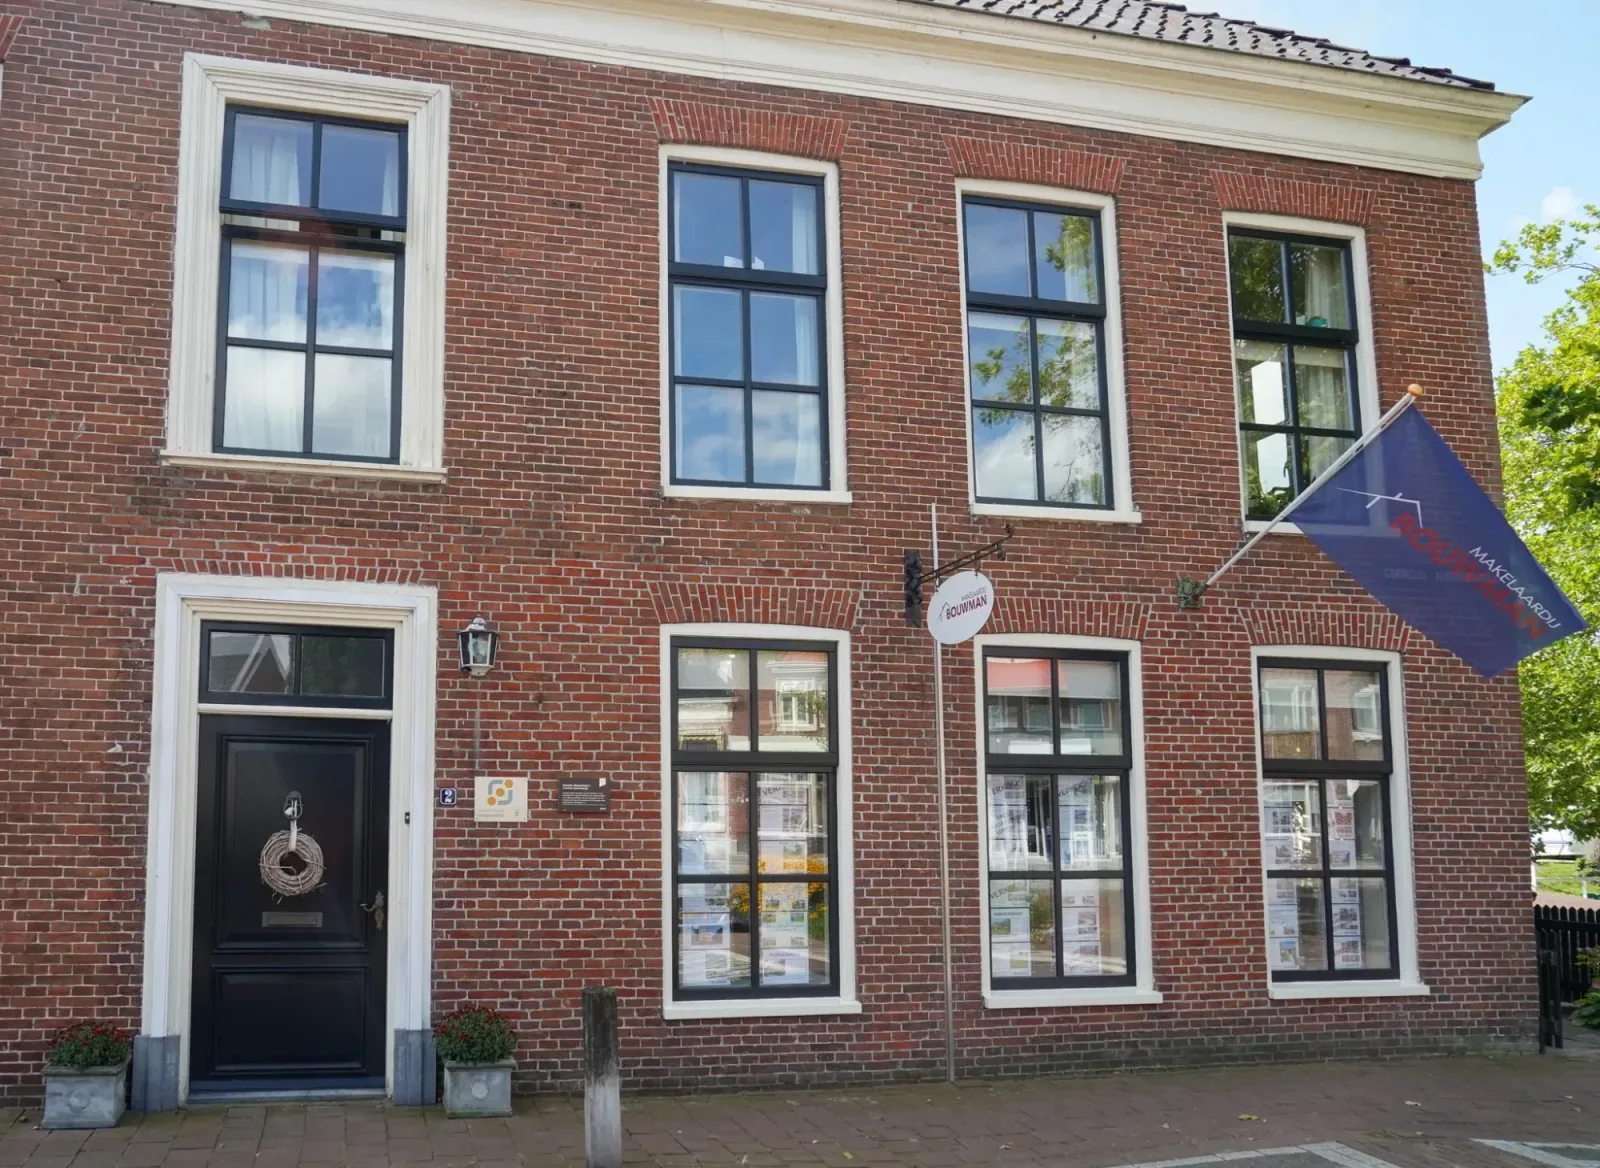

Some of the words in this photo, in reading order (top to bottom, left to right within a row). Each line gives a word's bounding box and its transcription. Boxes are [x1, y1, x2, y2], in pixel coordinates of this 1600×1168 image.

[1389, 512, 1549, 640] BOUWMAN
[1469, 546, 1562, 629] MAKELAARDIJ
[946, 594, 988, 620] BOUWMAN
[444, 790, 453, 803] 2
